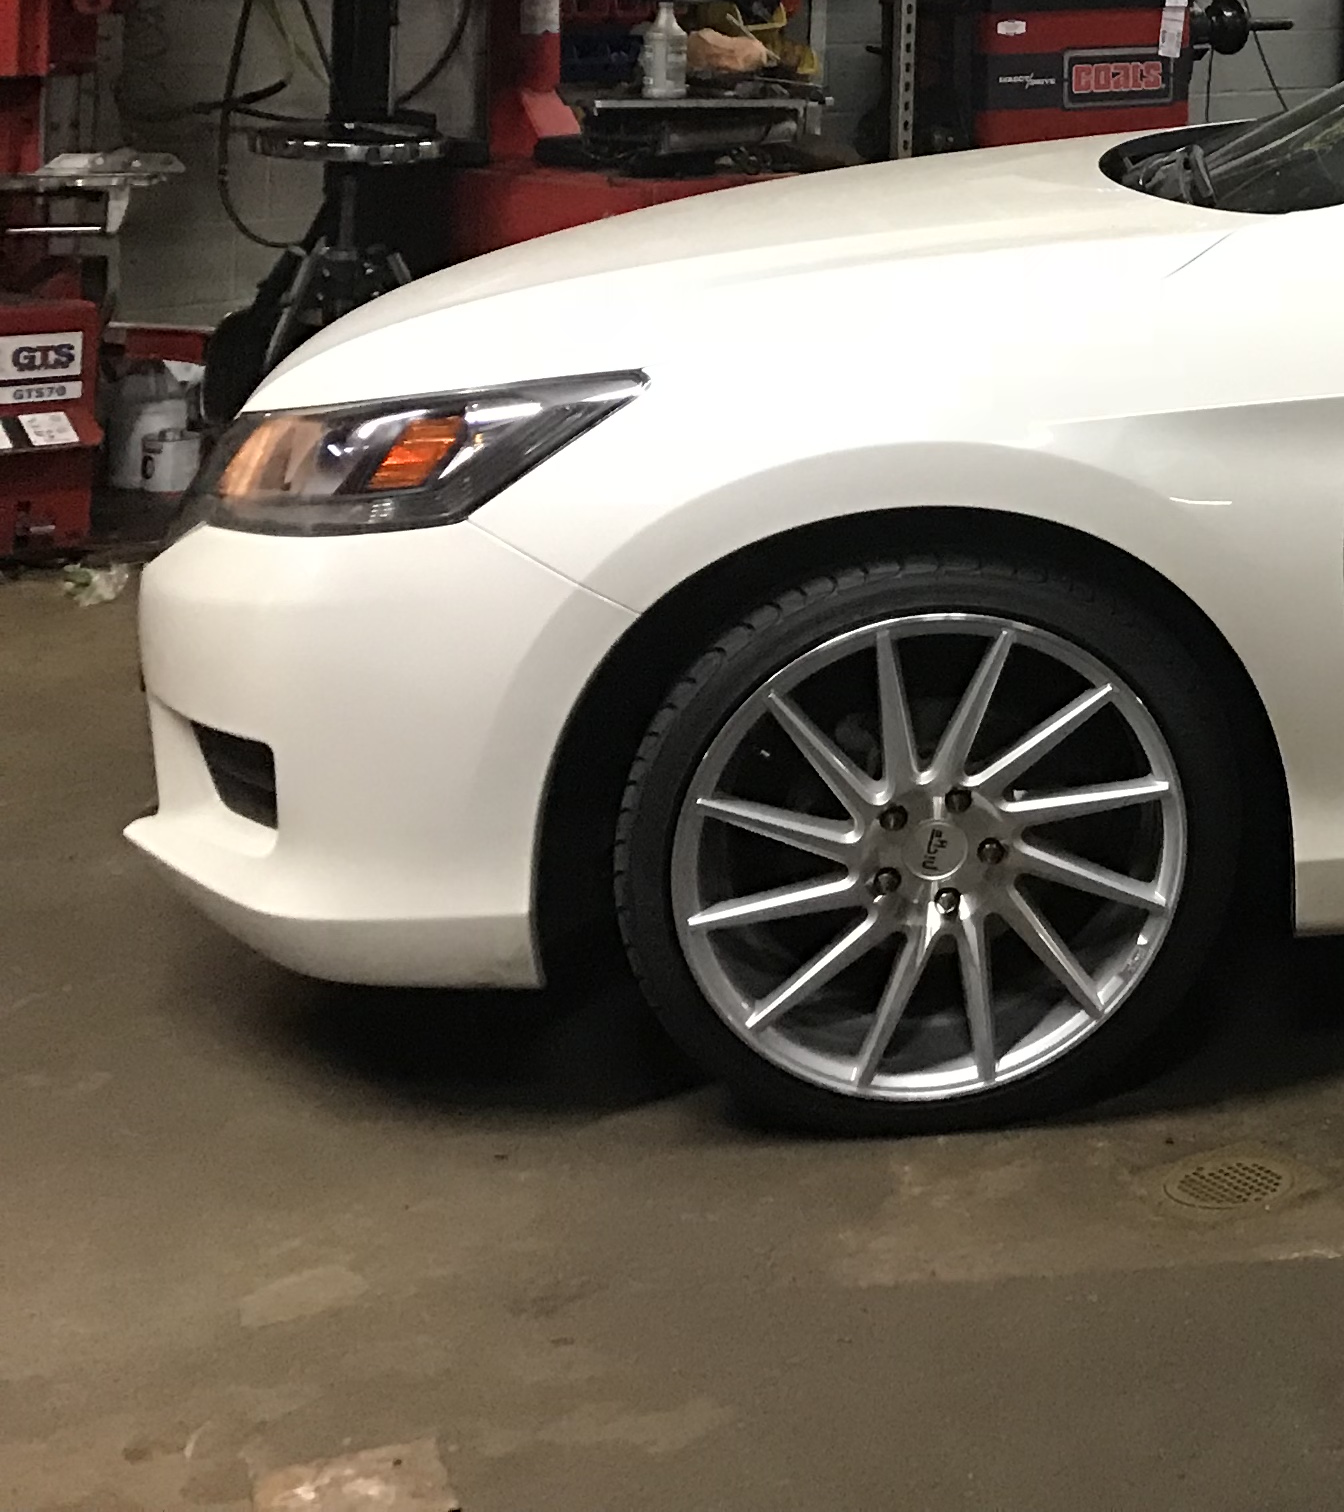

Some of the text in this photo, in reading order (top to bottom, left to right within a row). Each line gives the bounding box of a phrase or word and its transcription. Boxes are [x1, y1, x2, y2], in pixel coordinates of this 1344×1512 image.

[1072, 61, 1162, 94] COATS
[12, 343, 75, 371] GTS
[13, 386, 67, 400] GTS70
